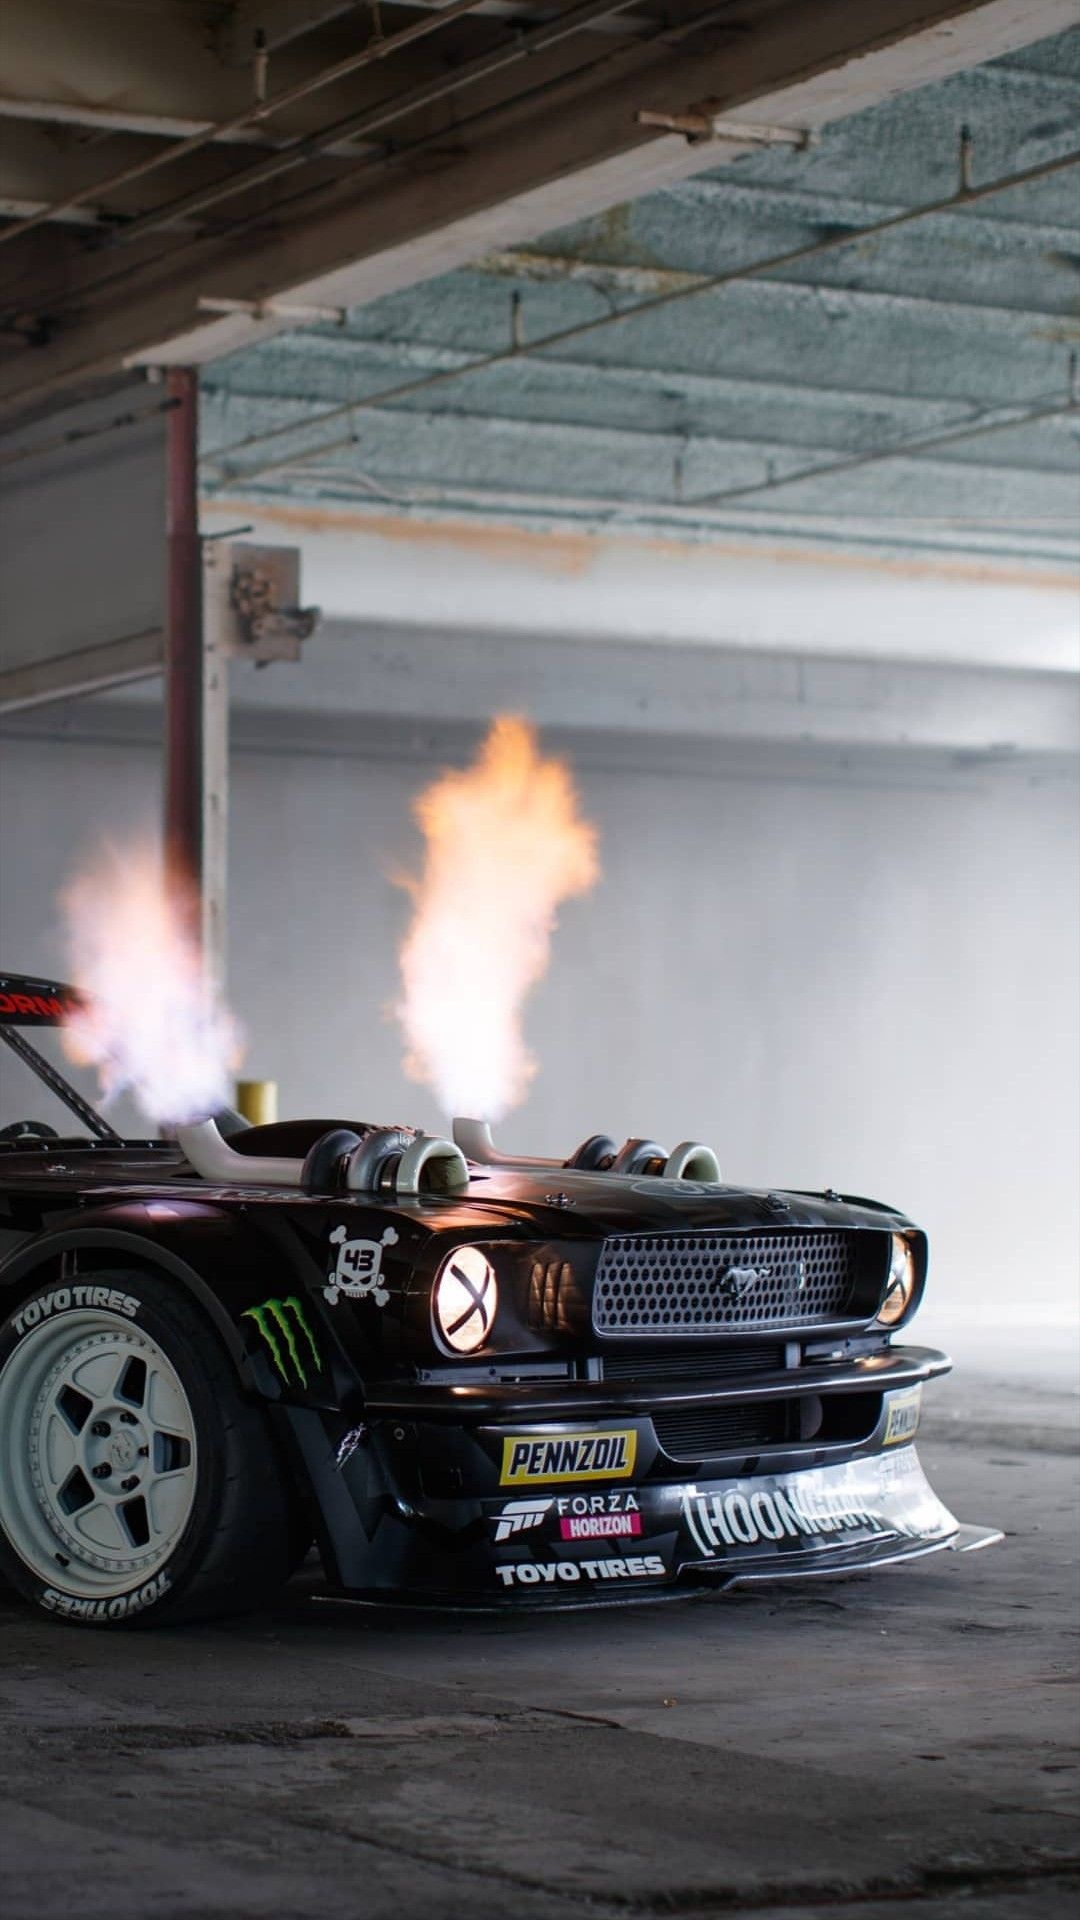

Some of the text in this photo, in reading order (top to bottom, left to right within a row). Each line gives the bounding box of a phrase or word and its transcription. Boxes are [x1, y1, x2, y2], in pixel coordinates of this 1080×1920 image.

[344, 1249, 375, 1271] 43
[11, 1286, 141, 1335] TOYO TIRES
[508, 1436, 628, 1477] PENNZOIL
[557, 1494, 639, 1515] FORZA
[569, 1515, 632, 1537] HORIZON
[496, 1556, 666, 1585] TOYO TIRES
[39, 1571, 172, 1620] TOYO TIRES
